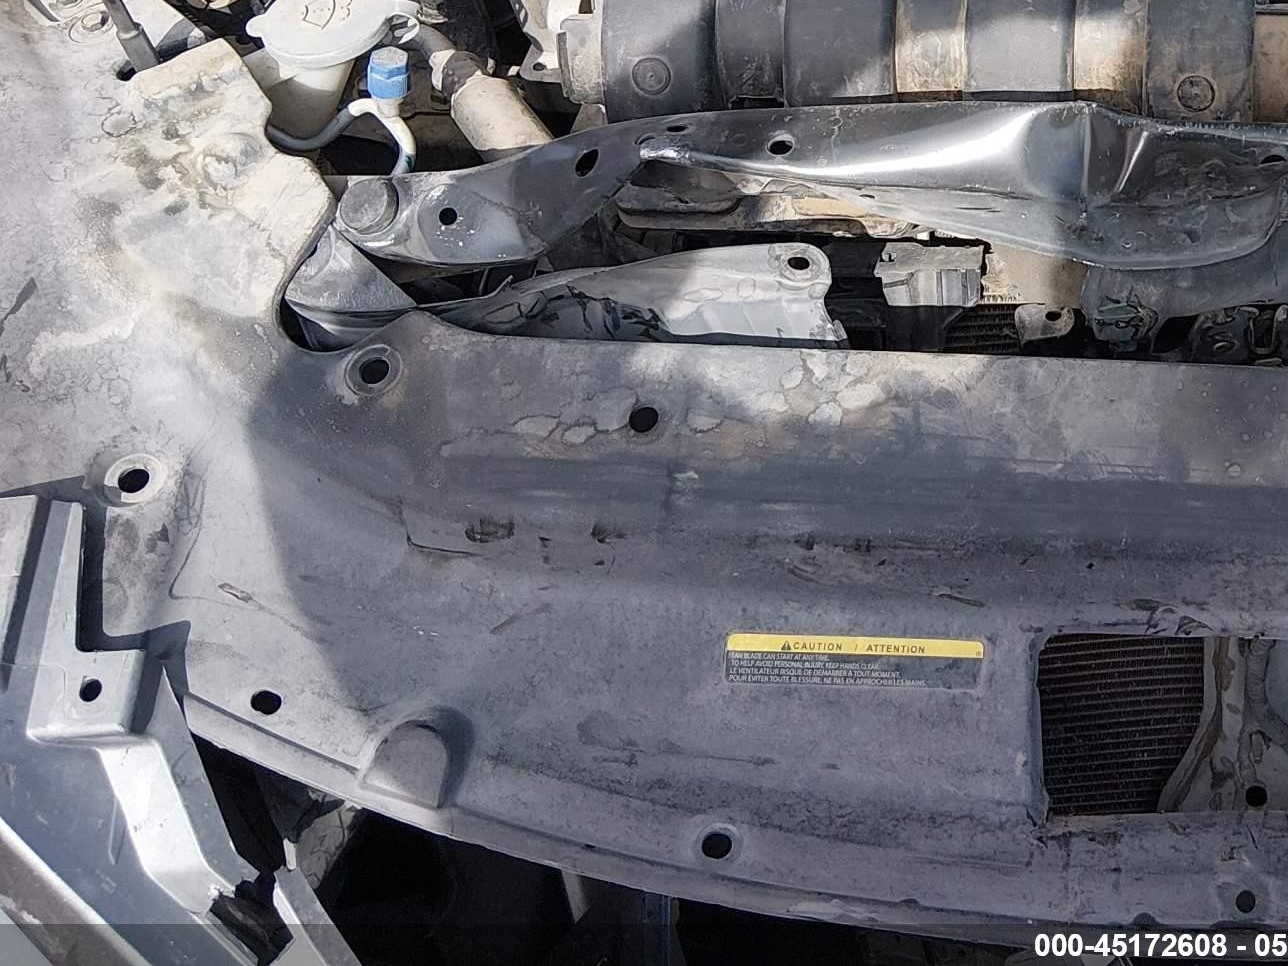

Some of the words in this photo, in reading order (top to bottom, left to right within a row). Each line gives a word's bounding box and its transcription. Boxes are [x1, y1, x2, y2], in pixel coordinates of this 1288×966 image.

[793, 642, 842, 651] CAUTION
[866, 644, 925, 654] ATTENTION
[738, 667, 779, 675] VENTILATEUR
[780, 668, 802, 676] RISQUE
[770, 675, 790, 683] TOUTE
